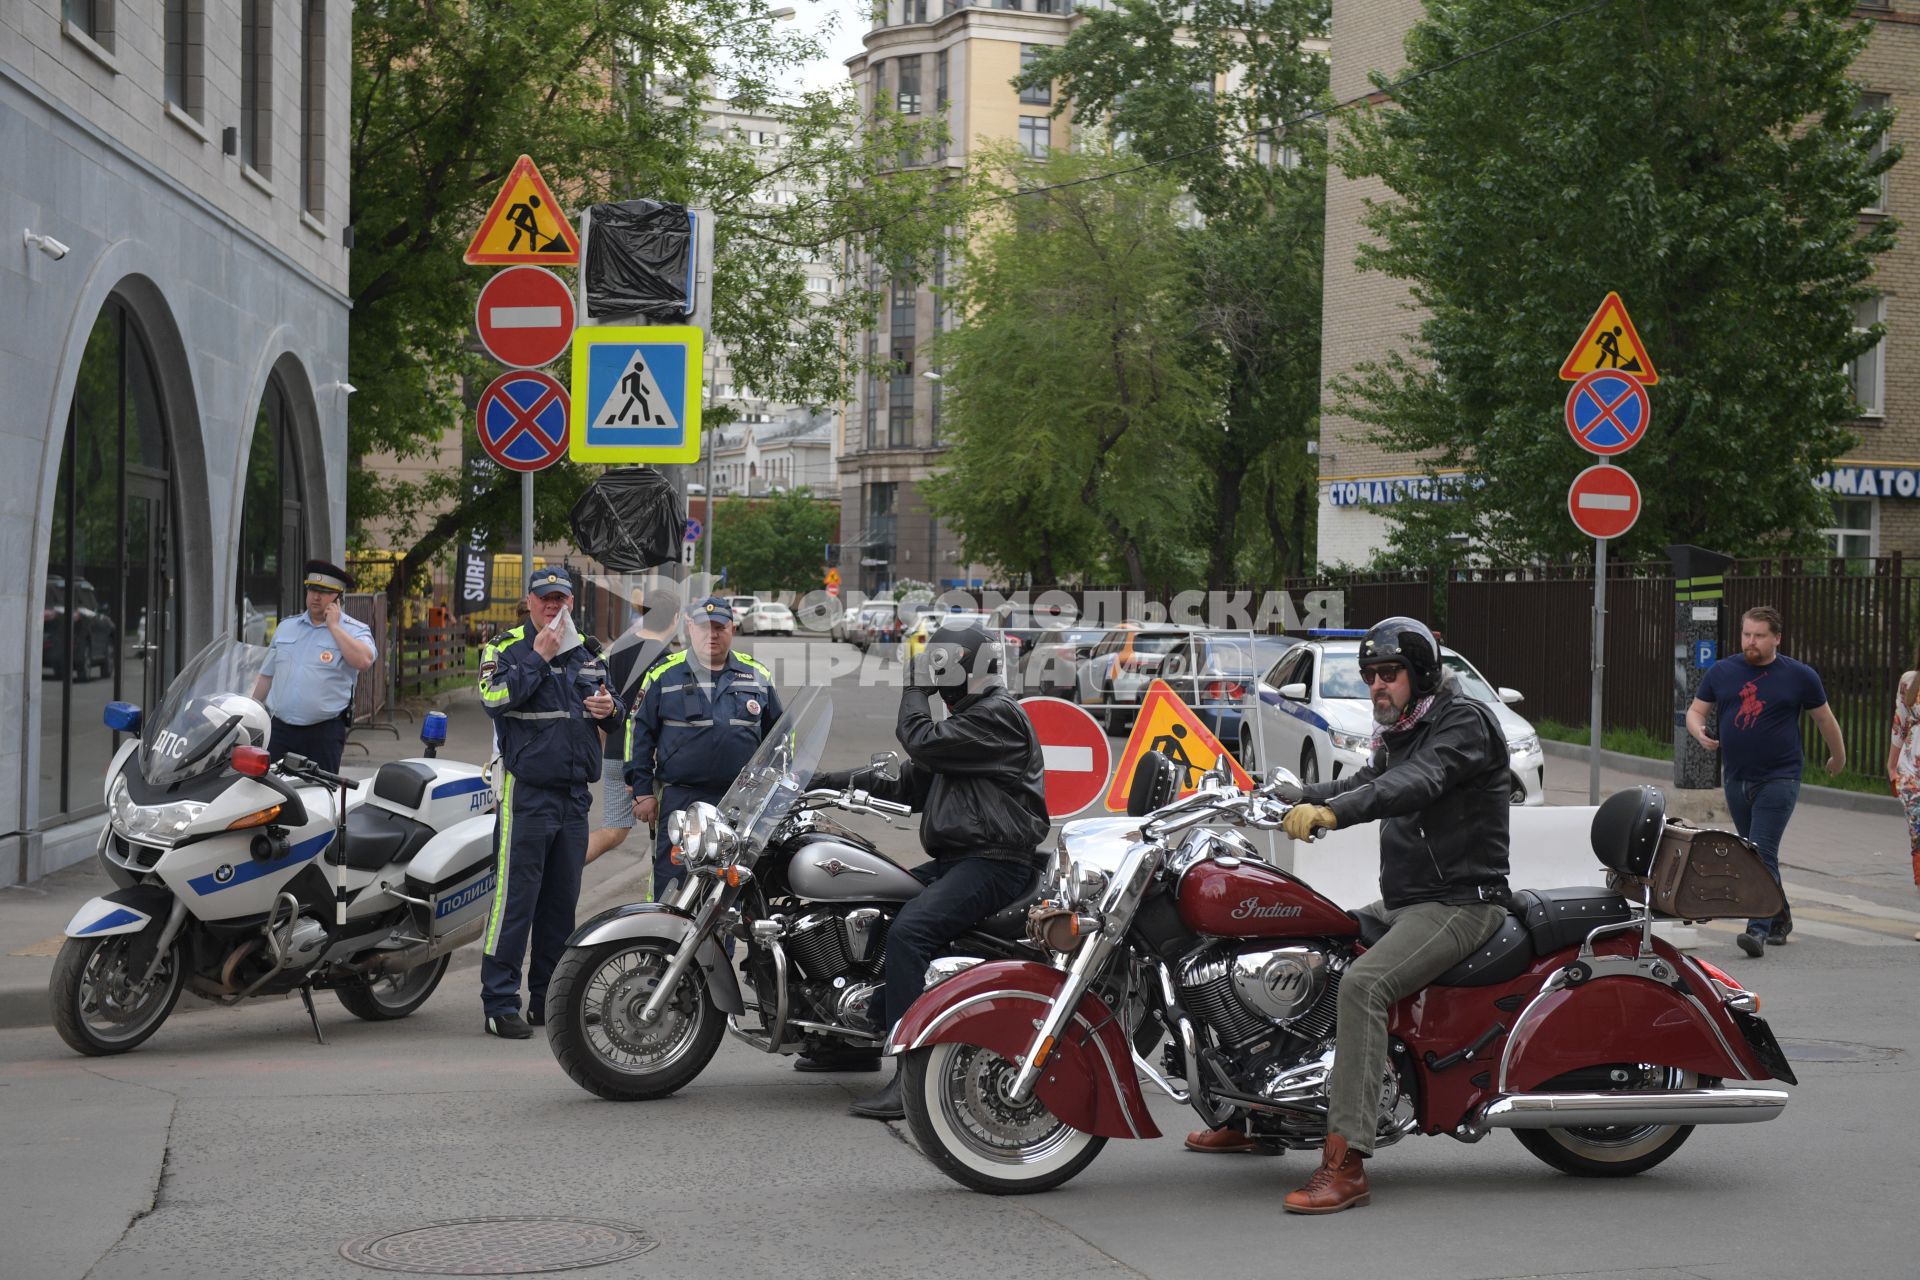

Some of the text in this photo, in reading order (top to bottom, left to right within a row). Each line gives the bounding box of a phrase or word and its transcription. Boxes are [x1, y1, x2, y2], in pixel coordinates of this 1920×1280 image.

[1808, 468, 1920, 497] ОМАТО
[463, 554, 485, 601] SURF
[1700, 647, 1712, 664] P
[151, 729, 188, 759] ДПС
[470, 790, 493, 811] ДПС
[441, 874, 497, 915] ПОЛИЦИ
[1231, 896, 1302, 919] Indian
[1270, 972, 1303, 991] 111
